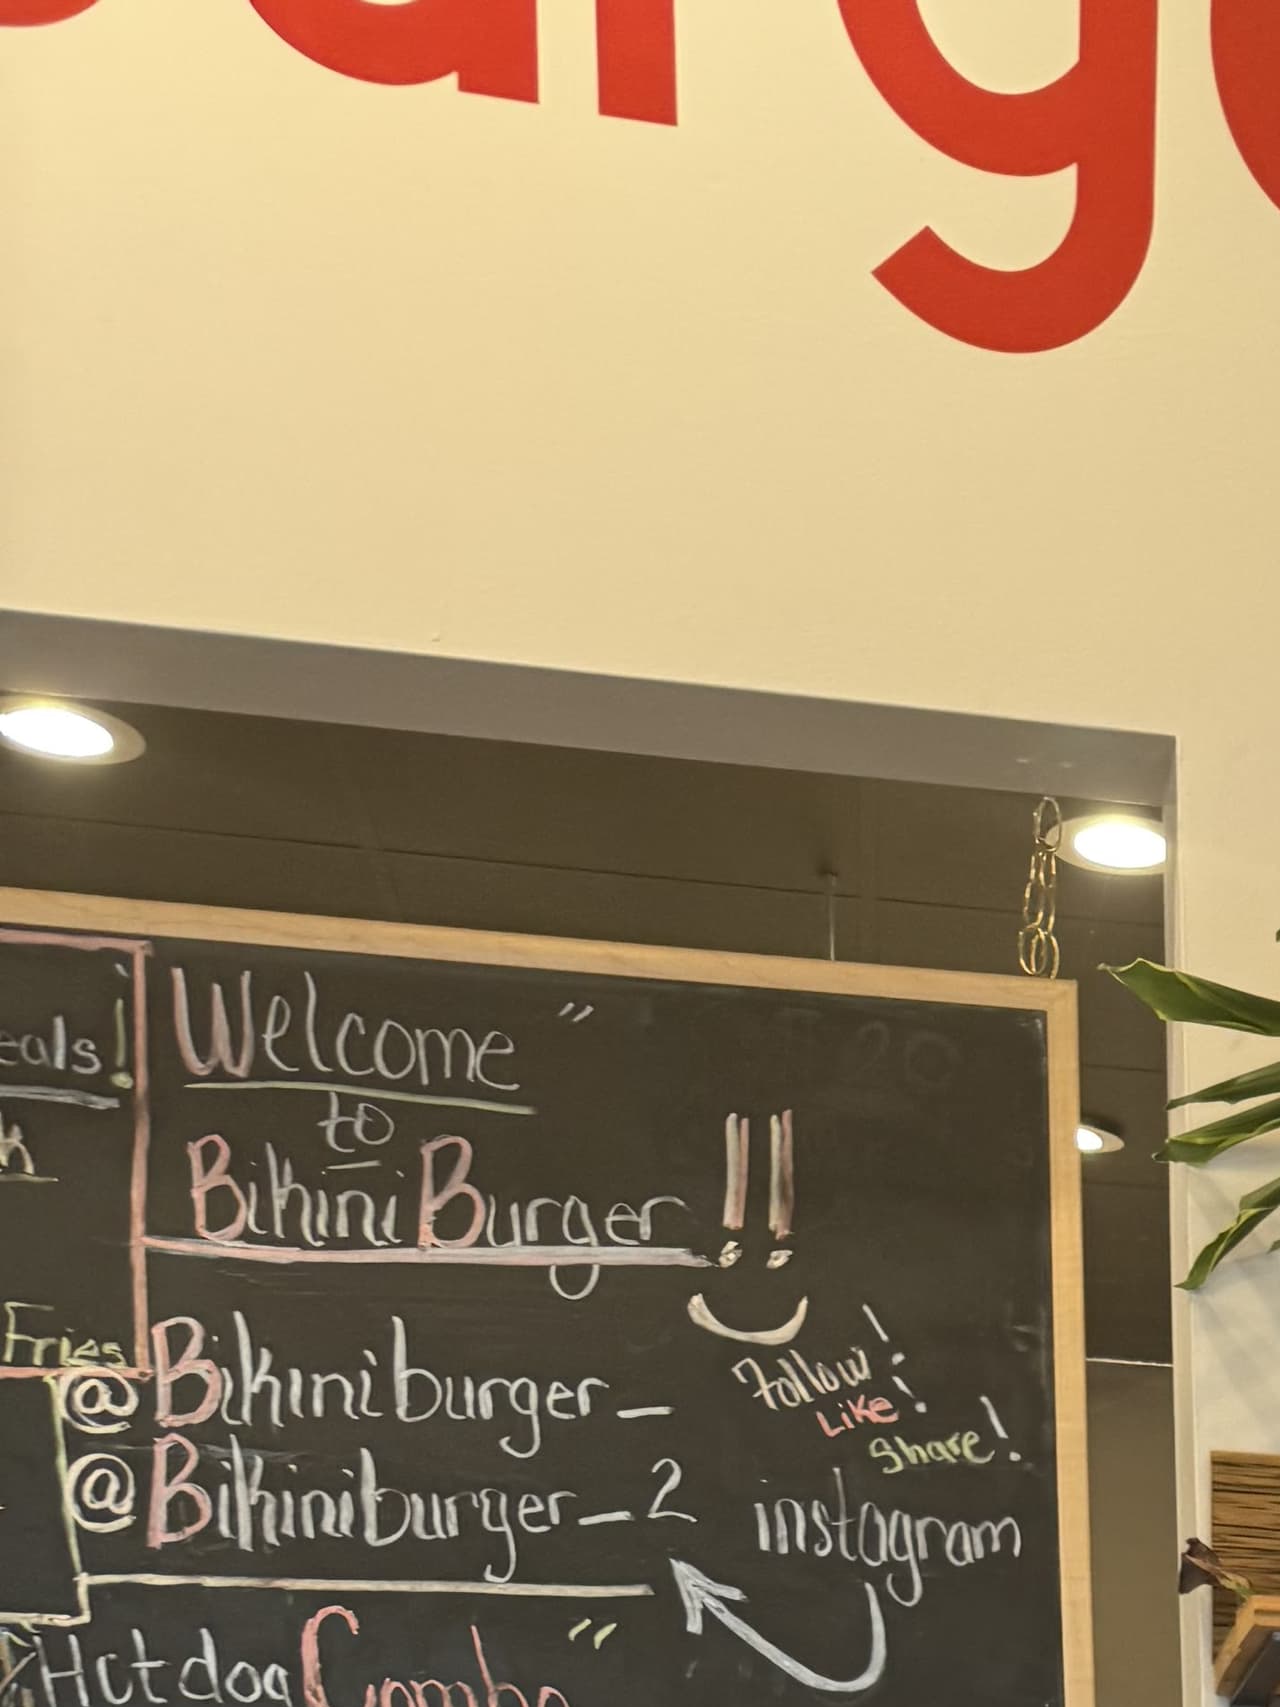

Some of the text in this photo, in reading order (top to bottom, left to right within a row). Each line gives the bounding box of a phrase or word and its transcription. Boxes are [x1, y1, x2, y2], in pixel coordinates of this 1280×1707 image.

[171, 964, 521, 1091] Welcome
[319, 1092, 394, 1152] to
[187, 1134, 404, 1248] Bikini
[418, 1134, 690, 1299] Burger
[0, 1301, 129, 1368] Fries
[754, 1467, 1022, 1607] instagram
